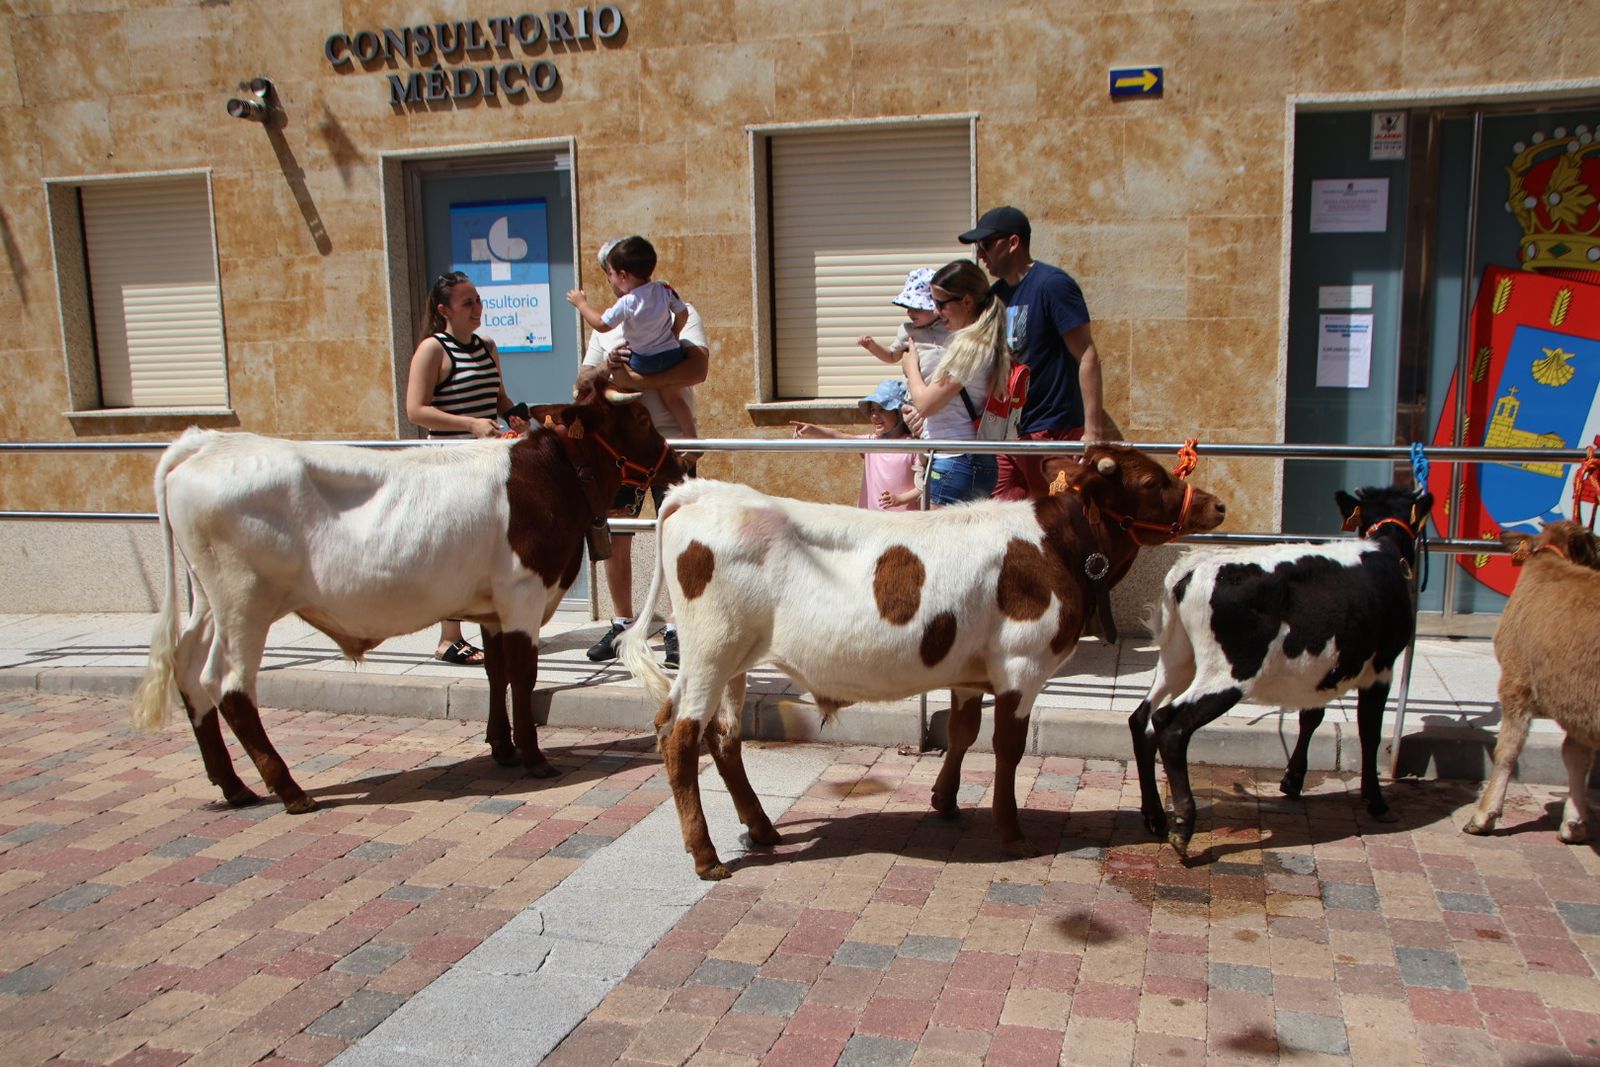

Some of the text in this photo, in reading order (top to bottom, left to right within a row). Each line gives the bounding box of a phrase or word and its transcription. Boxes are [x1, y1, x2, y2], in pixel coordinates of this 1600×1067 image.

[325, 5, 622, 65] CONSULTORIO
[388, 62, 557, 105] MÉDICO
[480, 294, 538, 309] nsultorio
[484, 312, 518, 326] Local
